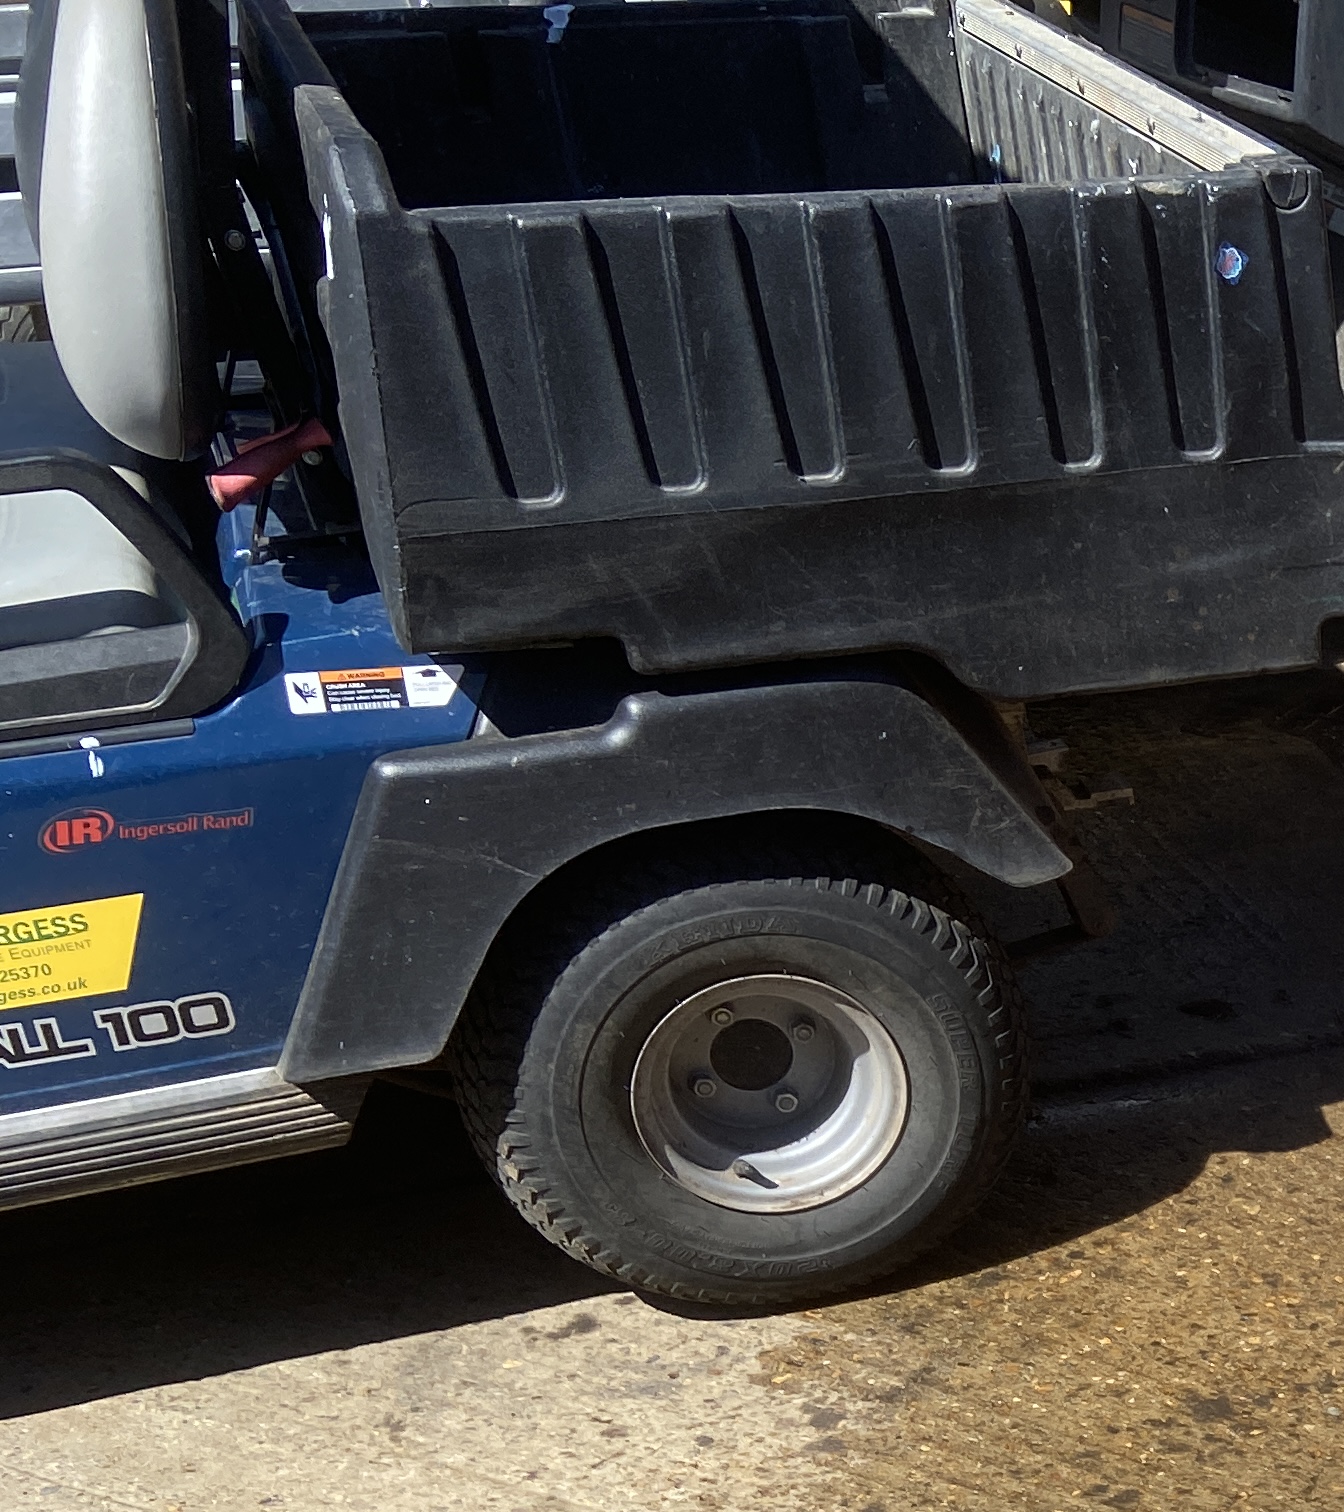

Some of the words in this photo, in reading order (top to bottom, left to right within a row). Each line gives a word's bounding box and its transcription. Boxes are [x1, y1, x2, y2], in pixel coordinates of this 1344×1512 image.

[56, 816, 102, 846] IR
[119, 817, 198, 840] Ingersoll
[203, 811, 249, 830] Rand
[95, 993, 234, 1051] 100
